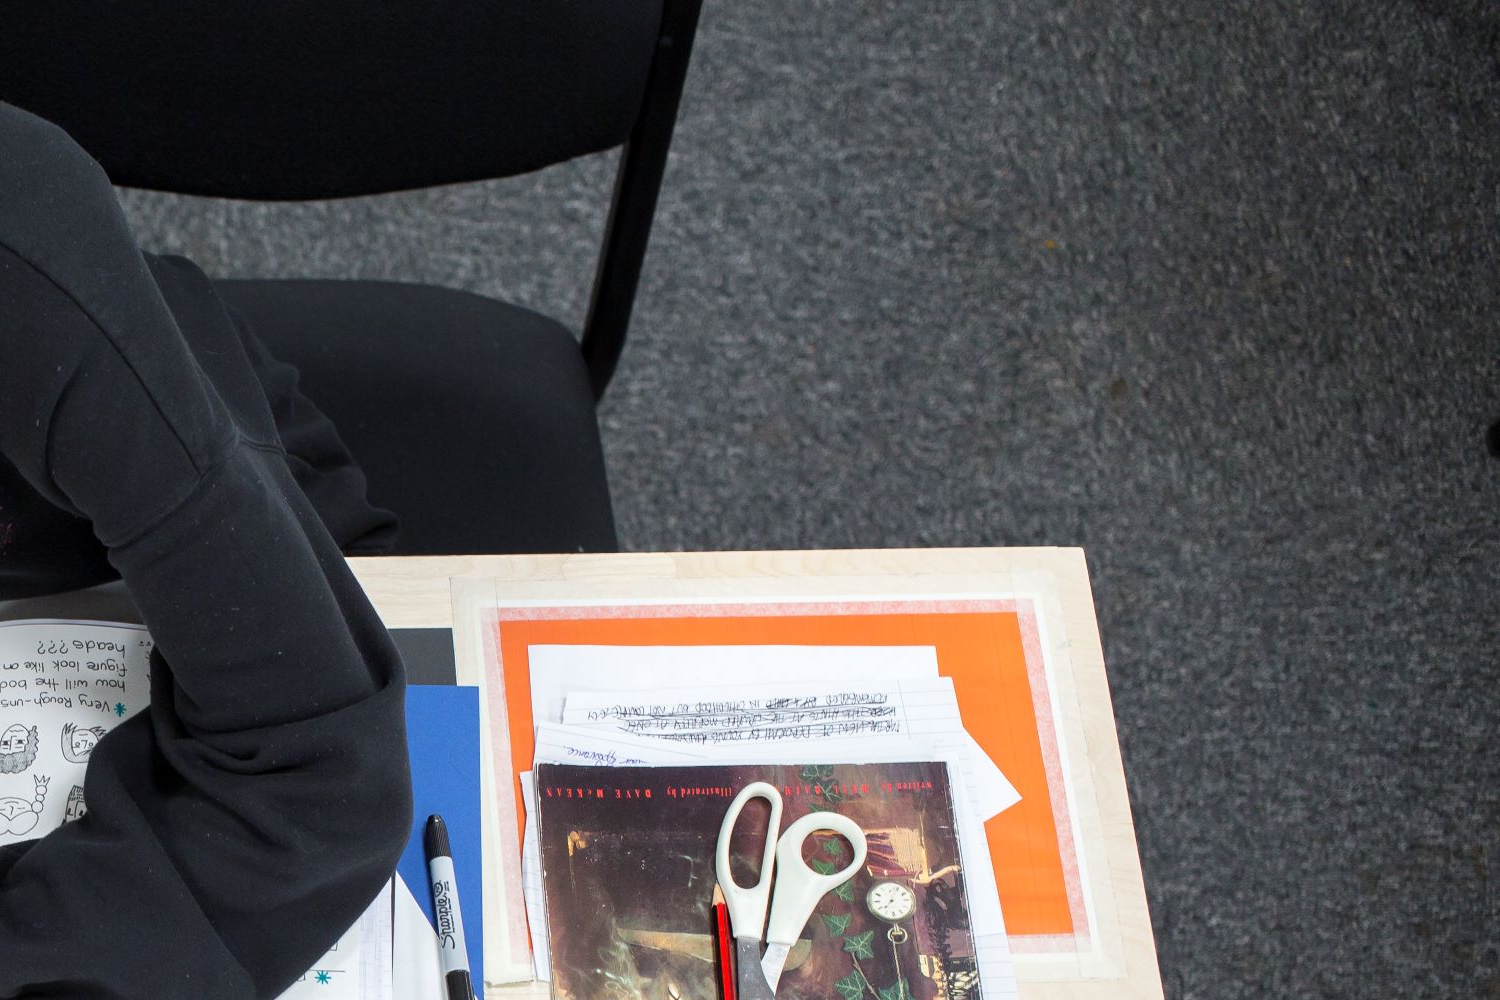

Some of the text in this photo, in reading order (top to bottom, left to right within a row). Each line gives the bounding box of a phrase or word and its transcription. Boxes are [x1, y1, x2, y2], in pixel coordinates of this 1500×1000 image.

[23, 661, 44, 673] like
[52, 660, 78, 670] look
[86, 659, 126, 676] figure
[34, 677, 58, 690] the
[64, 678, 86, 688] will
[95, 678, 124, 691] how
[78, 693, 109, 712] Very
[545, 784, 731, 797] illustrated by DAVE McKEAN
